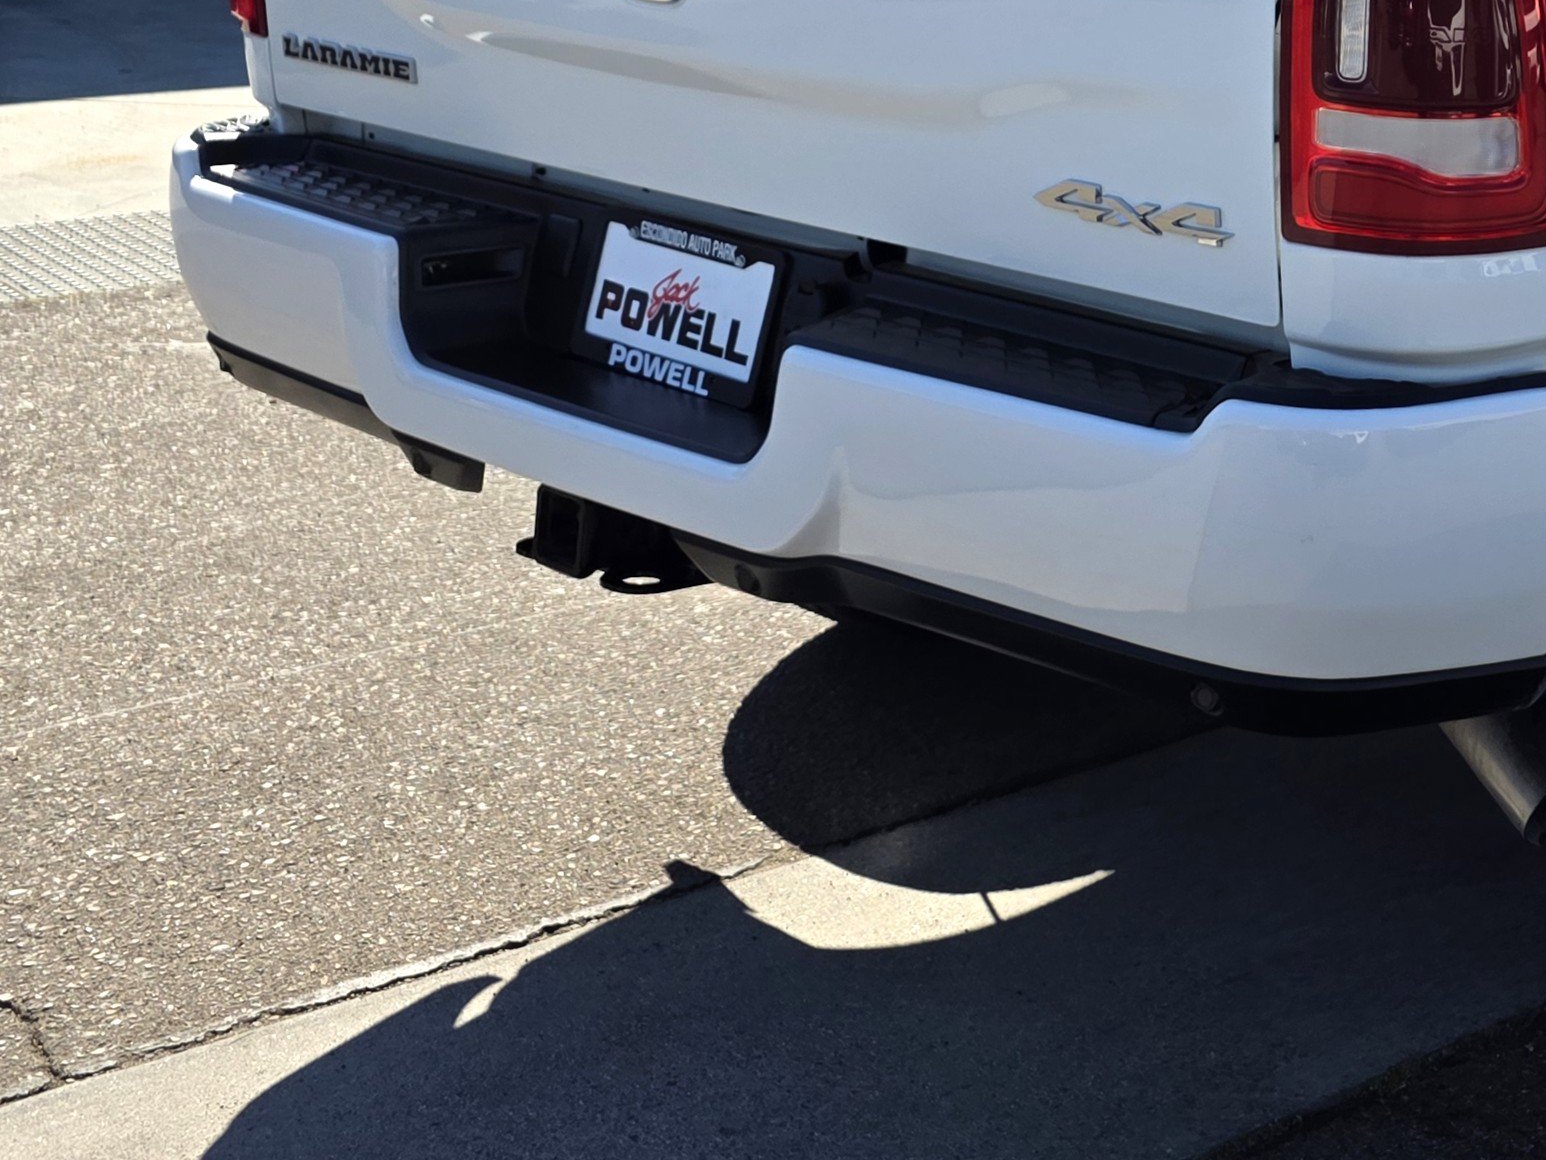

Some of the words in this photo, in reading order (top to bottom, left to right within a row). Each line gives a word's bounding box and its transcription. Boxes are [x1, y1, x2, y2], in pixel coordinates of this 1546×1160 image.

[282, 34, 418, 84] LARAMIE
[688, 234, 712, 256] AUTO
[712, 240, 738, 263] PARK
[648, 268, 700, 320] Jack
[596, 278, 749, 366] POWELL
[608, 342, 709, 397] POWELL
